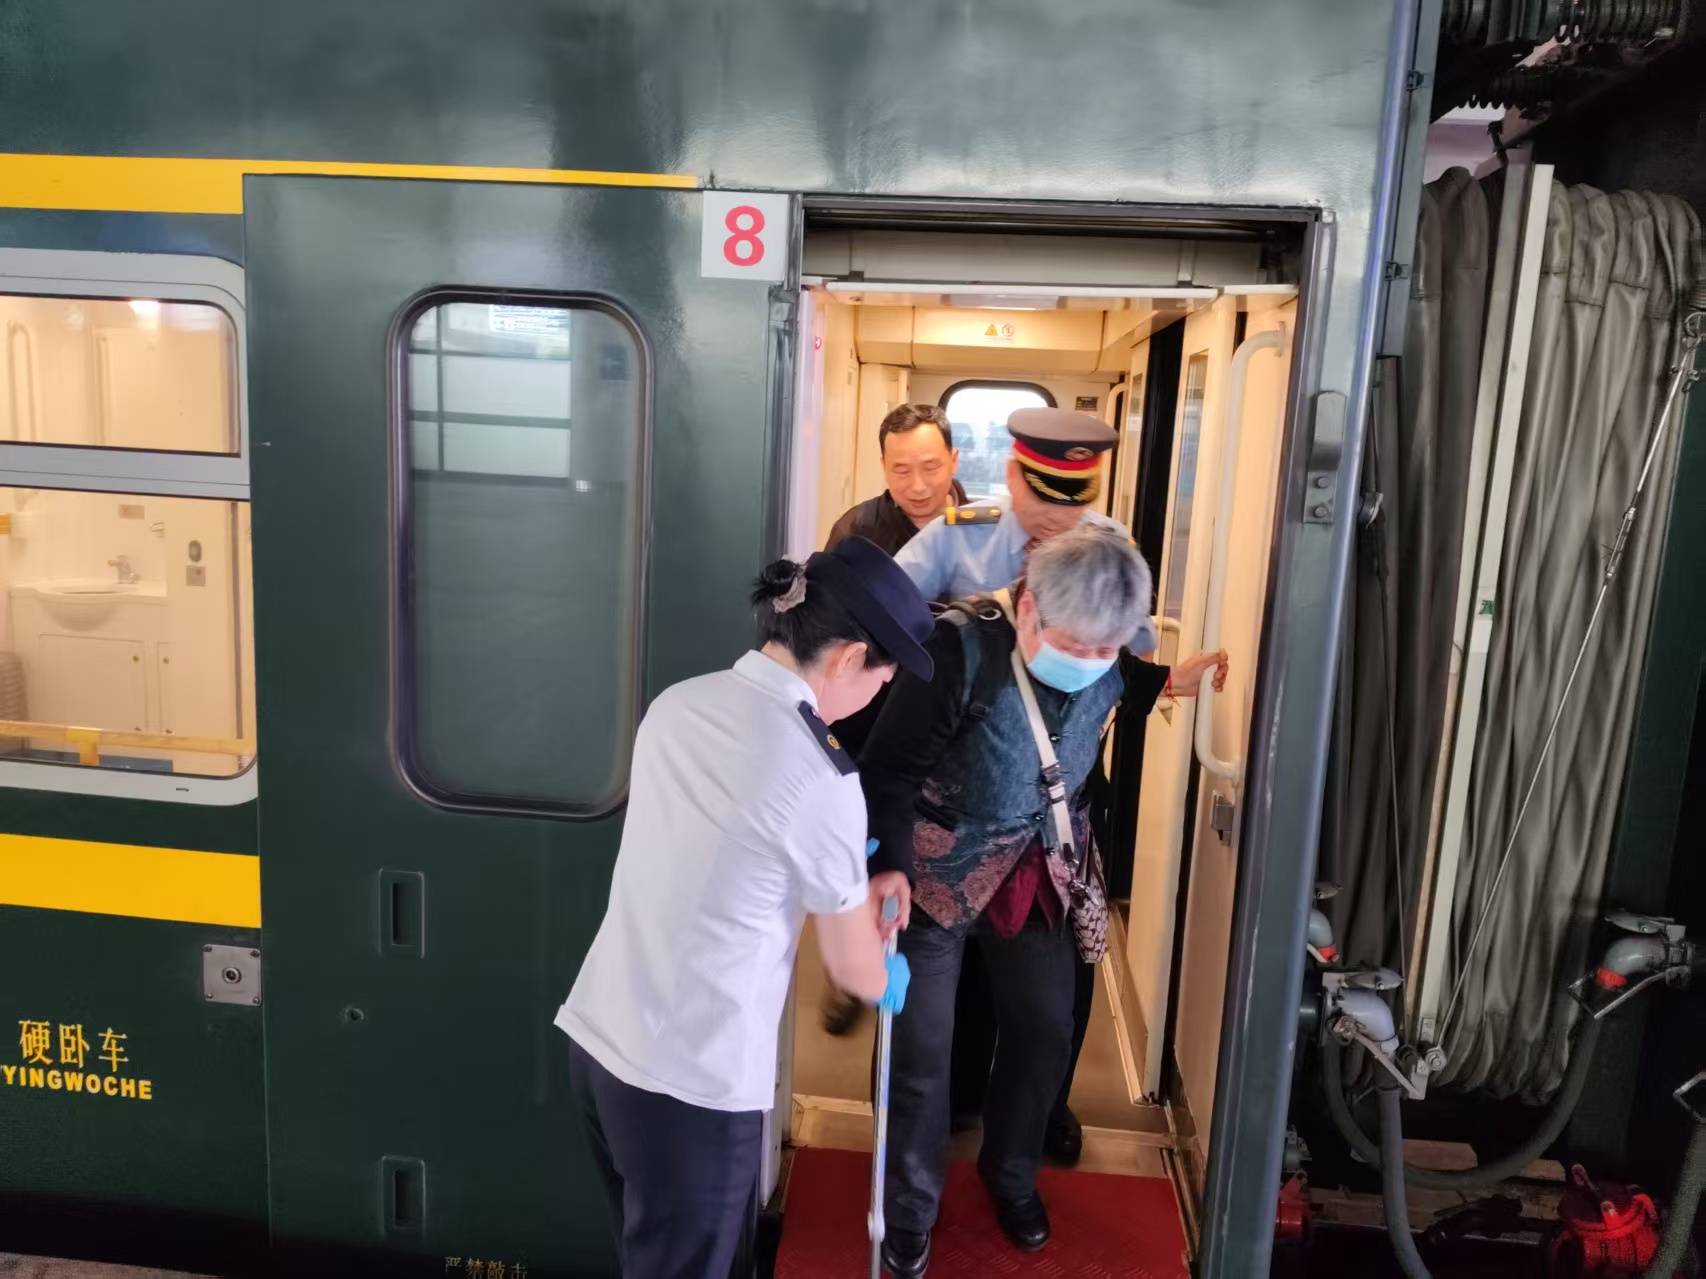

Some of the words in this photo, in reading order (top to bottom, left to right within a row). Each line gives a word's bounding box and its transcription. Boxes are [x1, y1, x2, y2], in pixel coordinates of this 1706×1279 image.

[723, 205, 766, 267] 8
[18, 1019, 129, 1072] 硬卧车
[1, 1064, 152, 1100] YINGWOCHE
